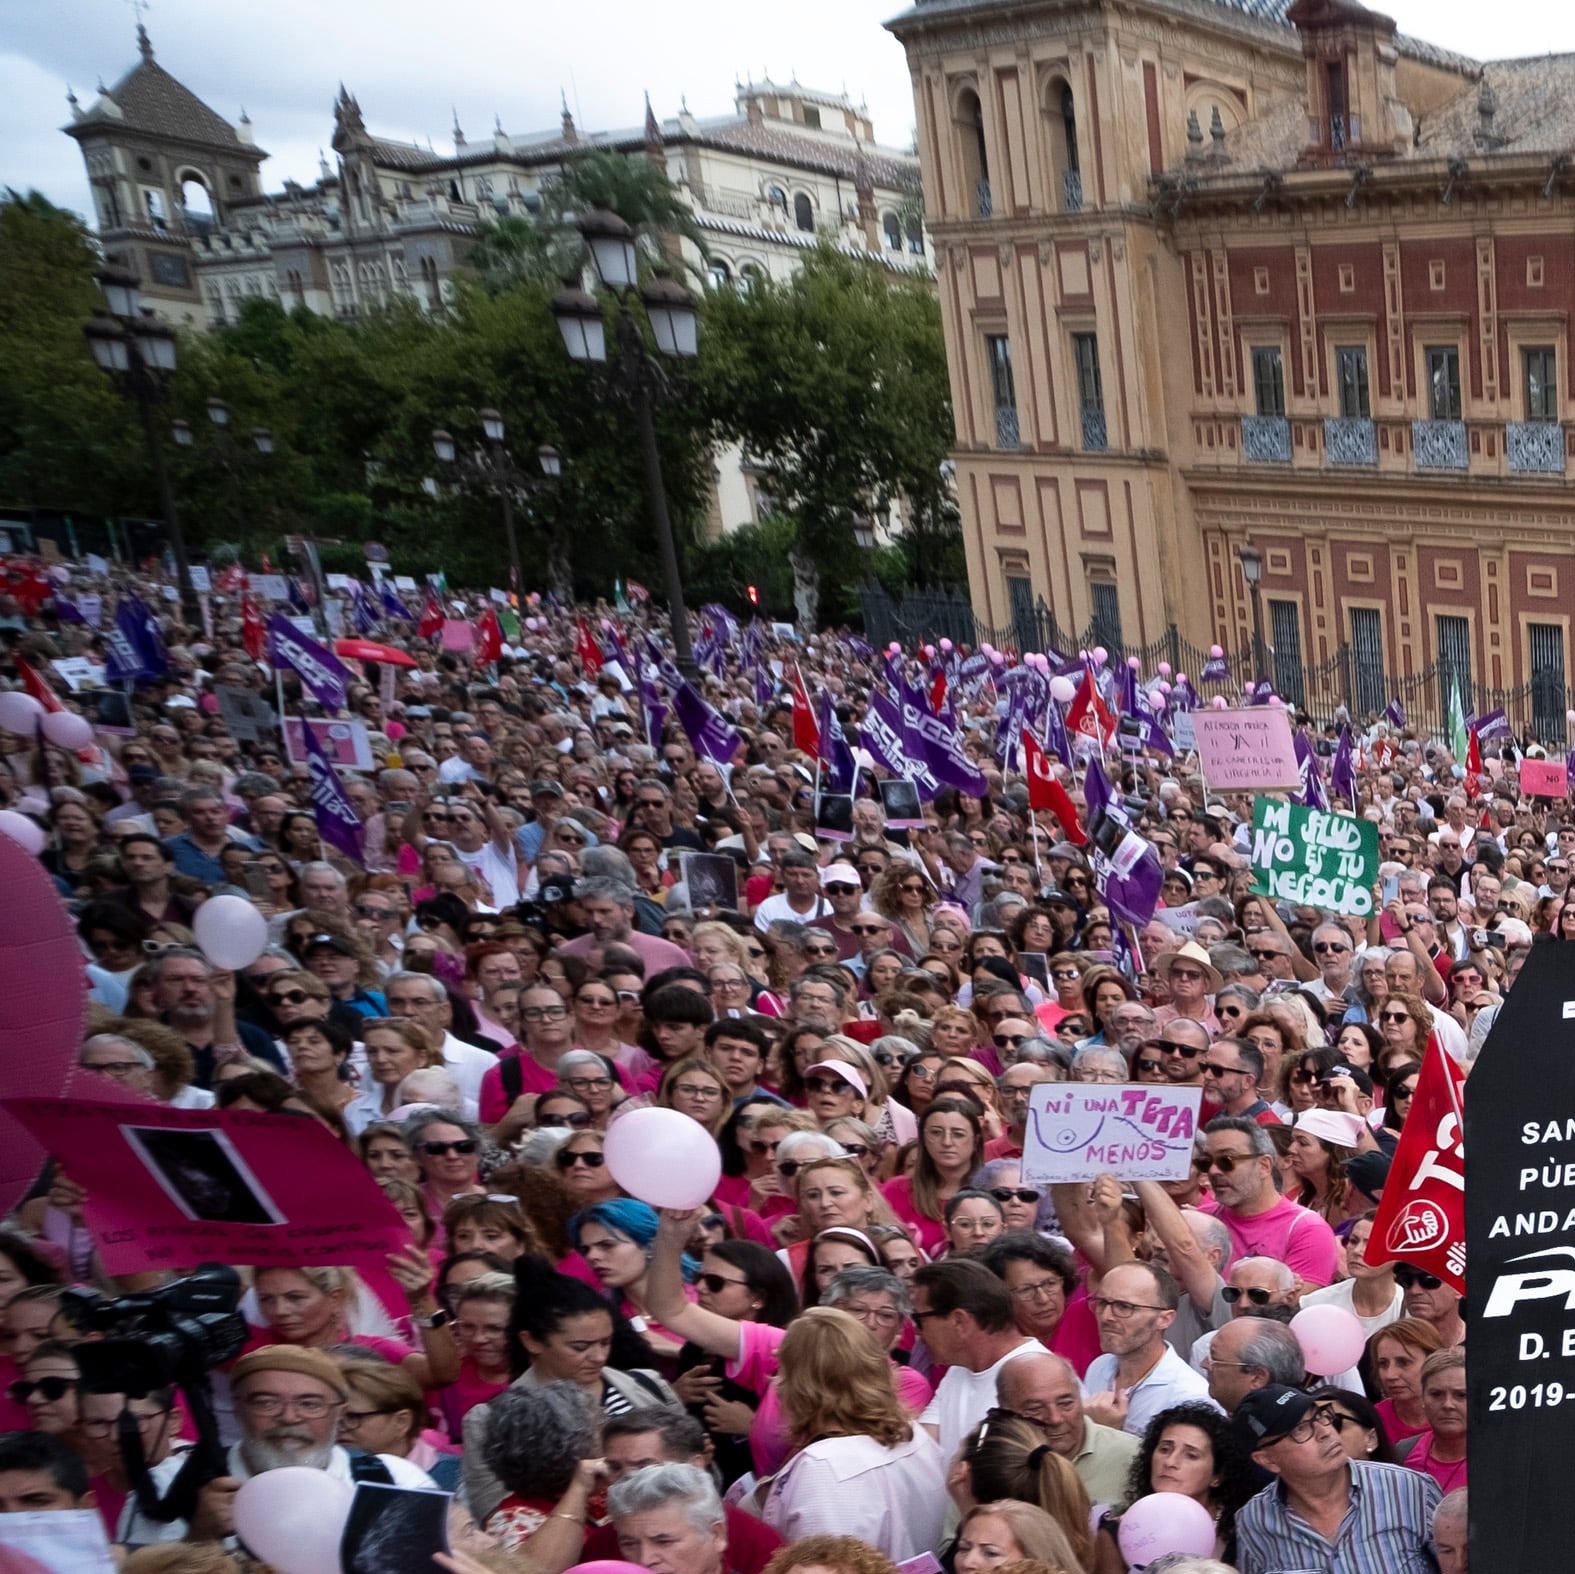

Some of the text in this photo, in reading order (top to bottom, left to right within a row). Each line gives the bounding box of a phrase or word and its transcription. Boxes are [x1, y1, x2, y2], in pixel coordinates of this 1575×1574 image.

[1301, 809, 1361, 851] SALUD
[1252, 829, 1364, 878] NO ES TU
[1269, 869, 1372, 915] NEGOCIO
[1085, 1098, 1119, 1112] UNA
[1121, 1090, 1193, 1139] TETA
[1086, 1140, 1166, 1164] MENOS
